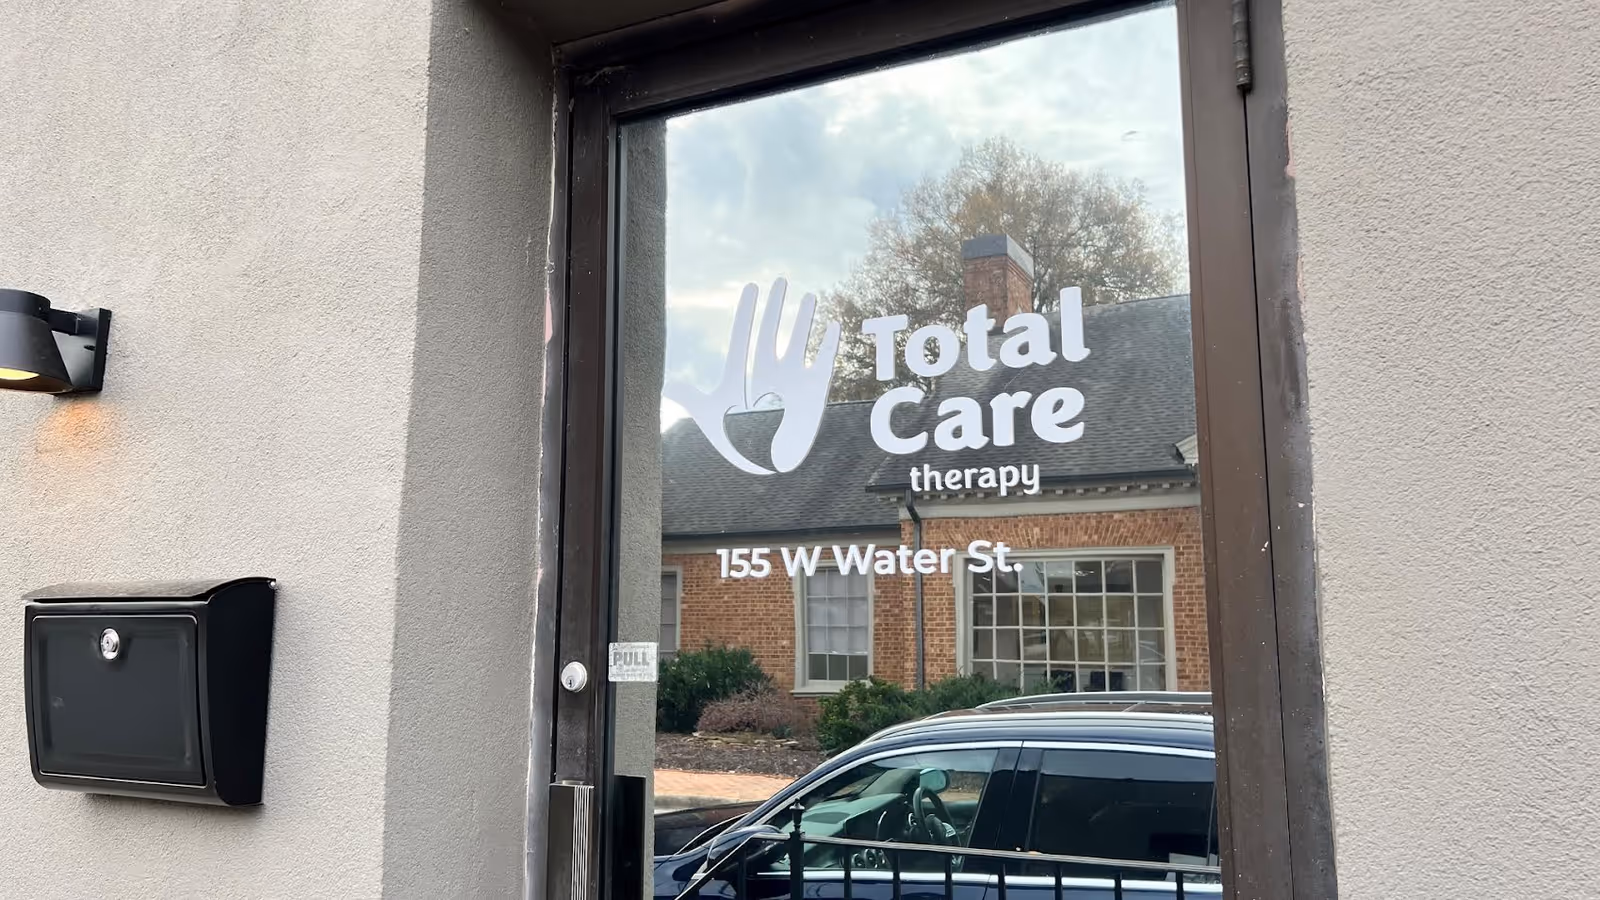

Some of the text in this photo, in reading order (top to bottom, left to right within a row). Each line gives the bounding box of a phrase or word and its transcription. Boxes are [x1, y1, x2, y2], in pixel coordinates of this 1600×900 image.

[862, 286, 1091, 381] Total
[870, 386, 1085, 455] Care
[910, 463, 1040, 496] therapy
[716, 539, 1024, 578] 155 W Water St.
[613, 651, 650, 666] PULL
